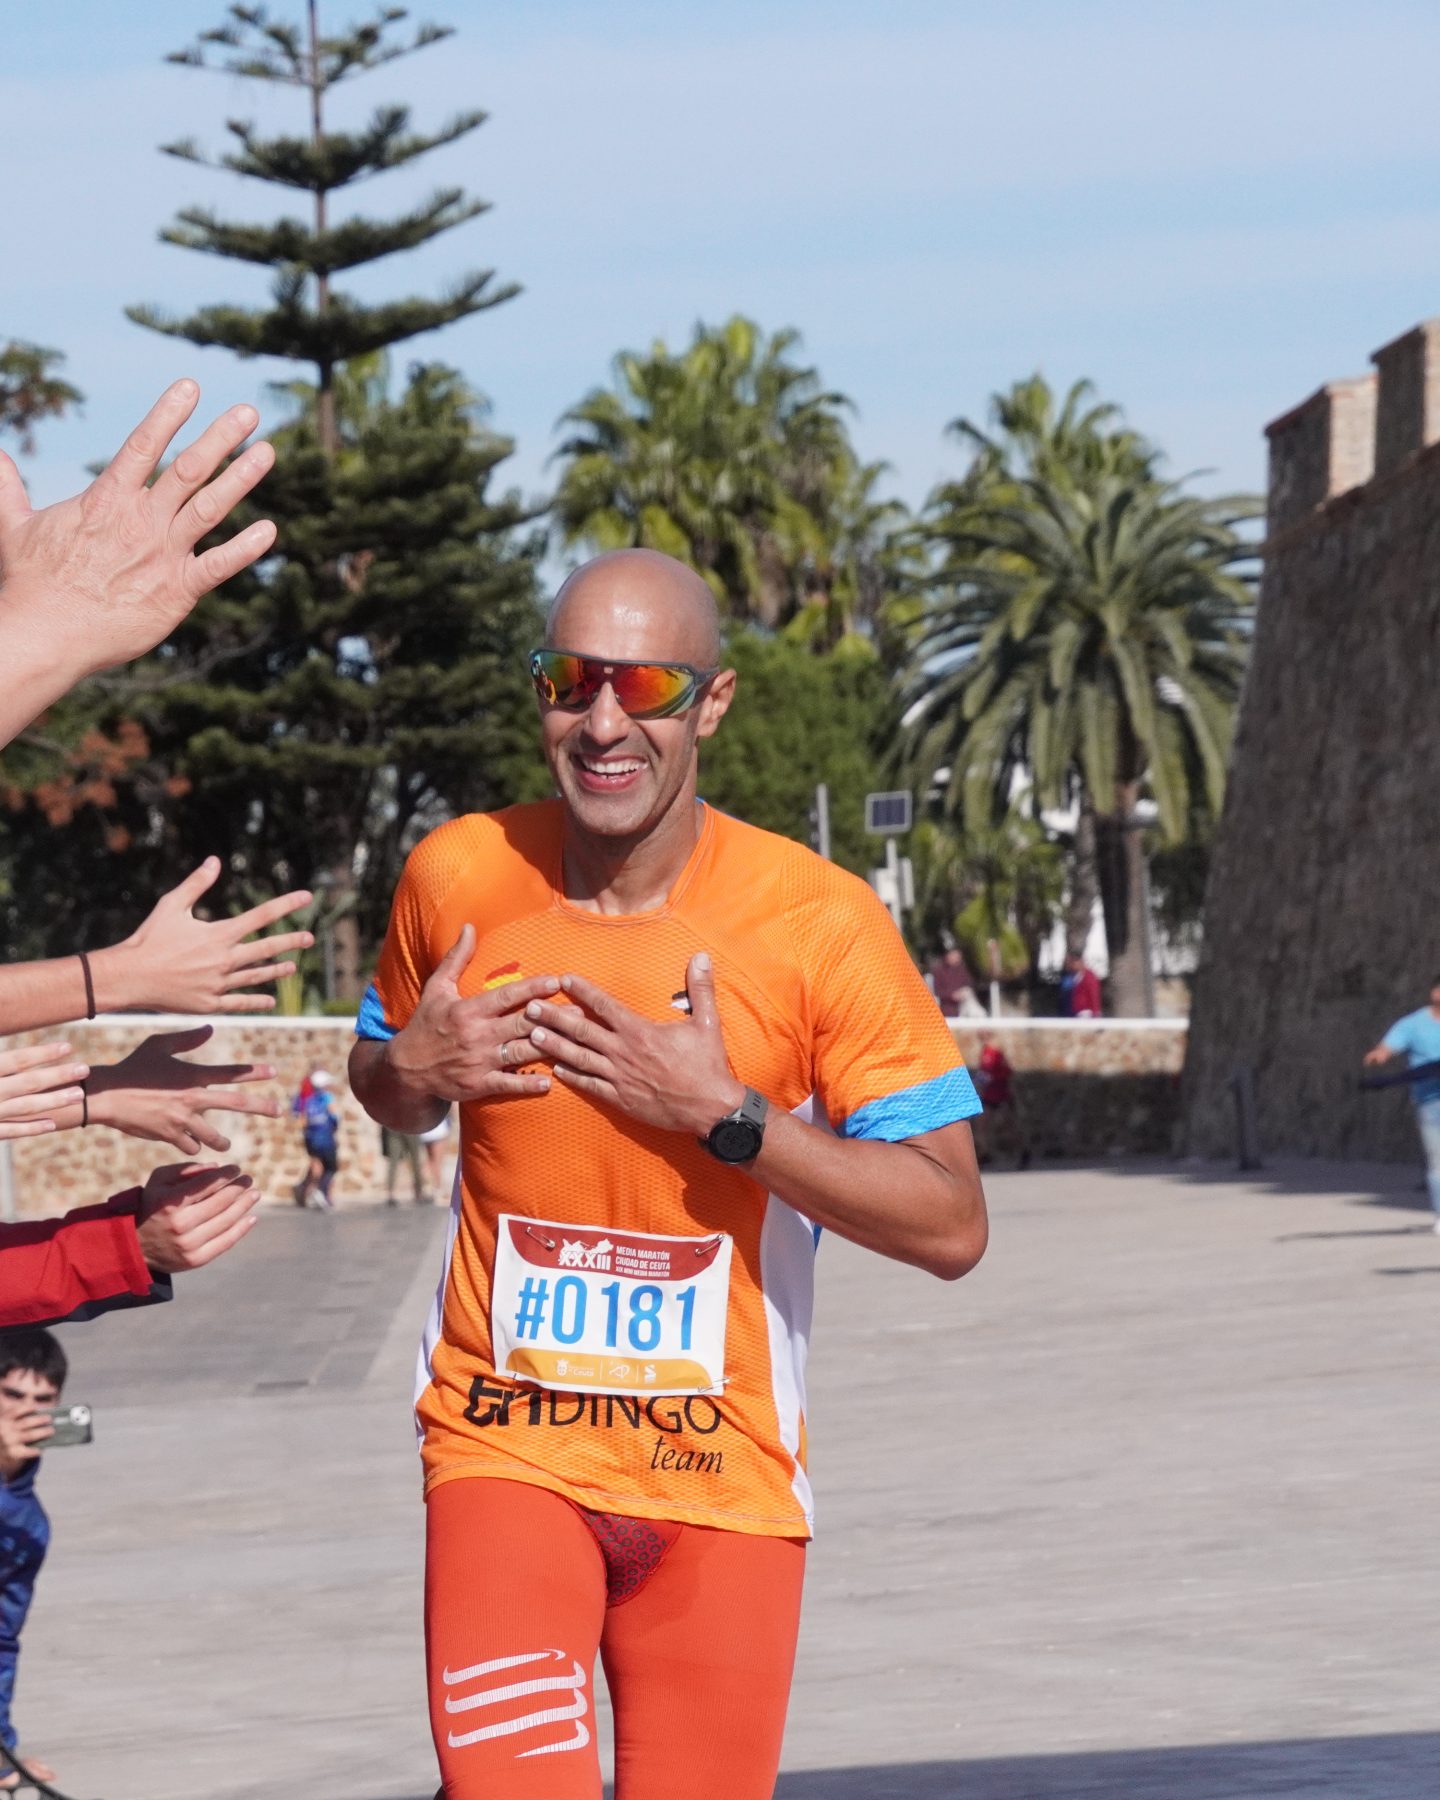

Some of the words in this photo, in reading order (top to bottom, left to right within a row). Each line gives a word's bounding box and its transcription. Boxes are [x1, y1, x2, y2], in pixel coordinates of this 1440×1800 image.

[616, 1246, 637, 1257] MEDIA
[637, 1249, 670, 1260] MARATÓN
[616, 1256, 639, 1268] CIUDAD
[639, 1260, 649, 1269] DE
[649, 1261, 670, 1270] CEUTA
[515, 1275, 697, 1351] #0181
[650, 1435, 725, 1473] team
